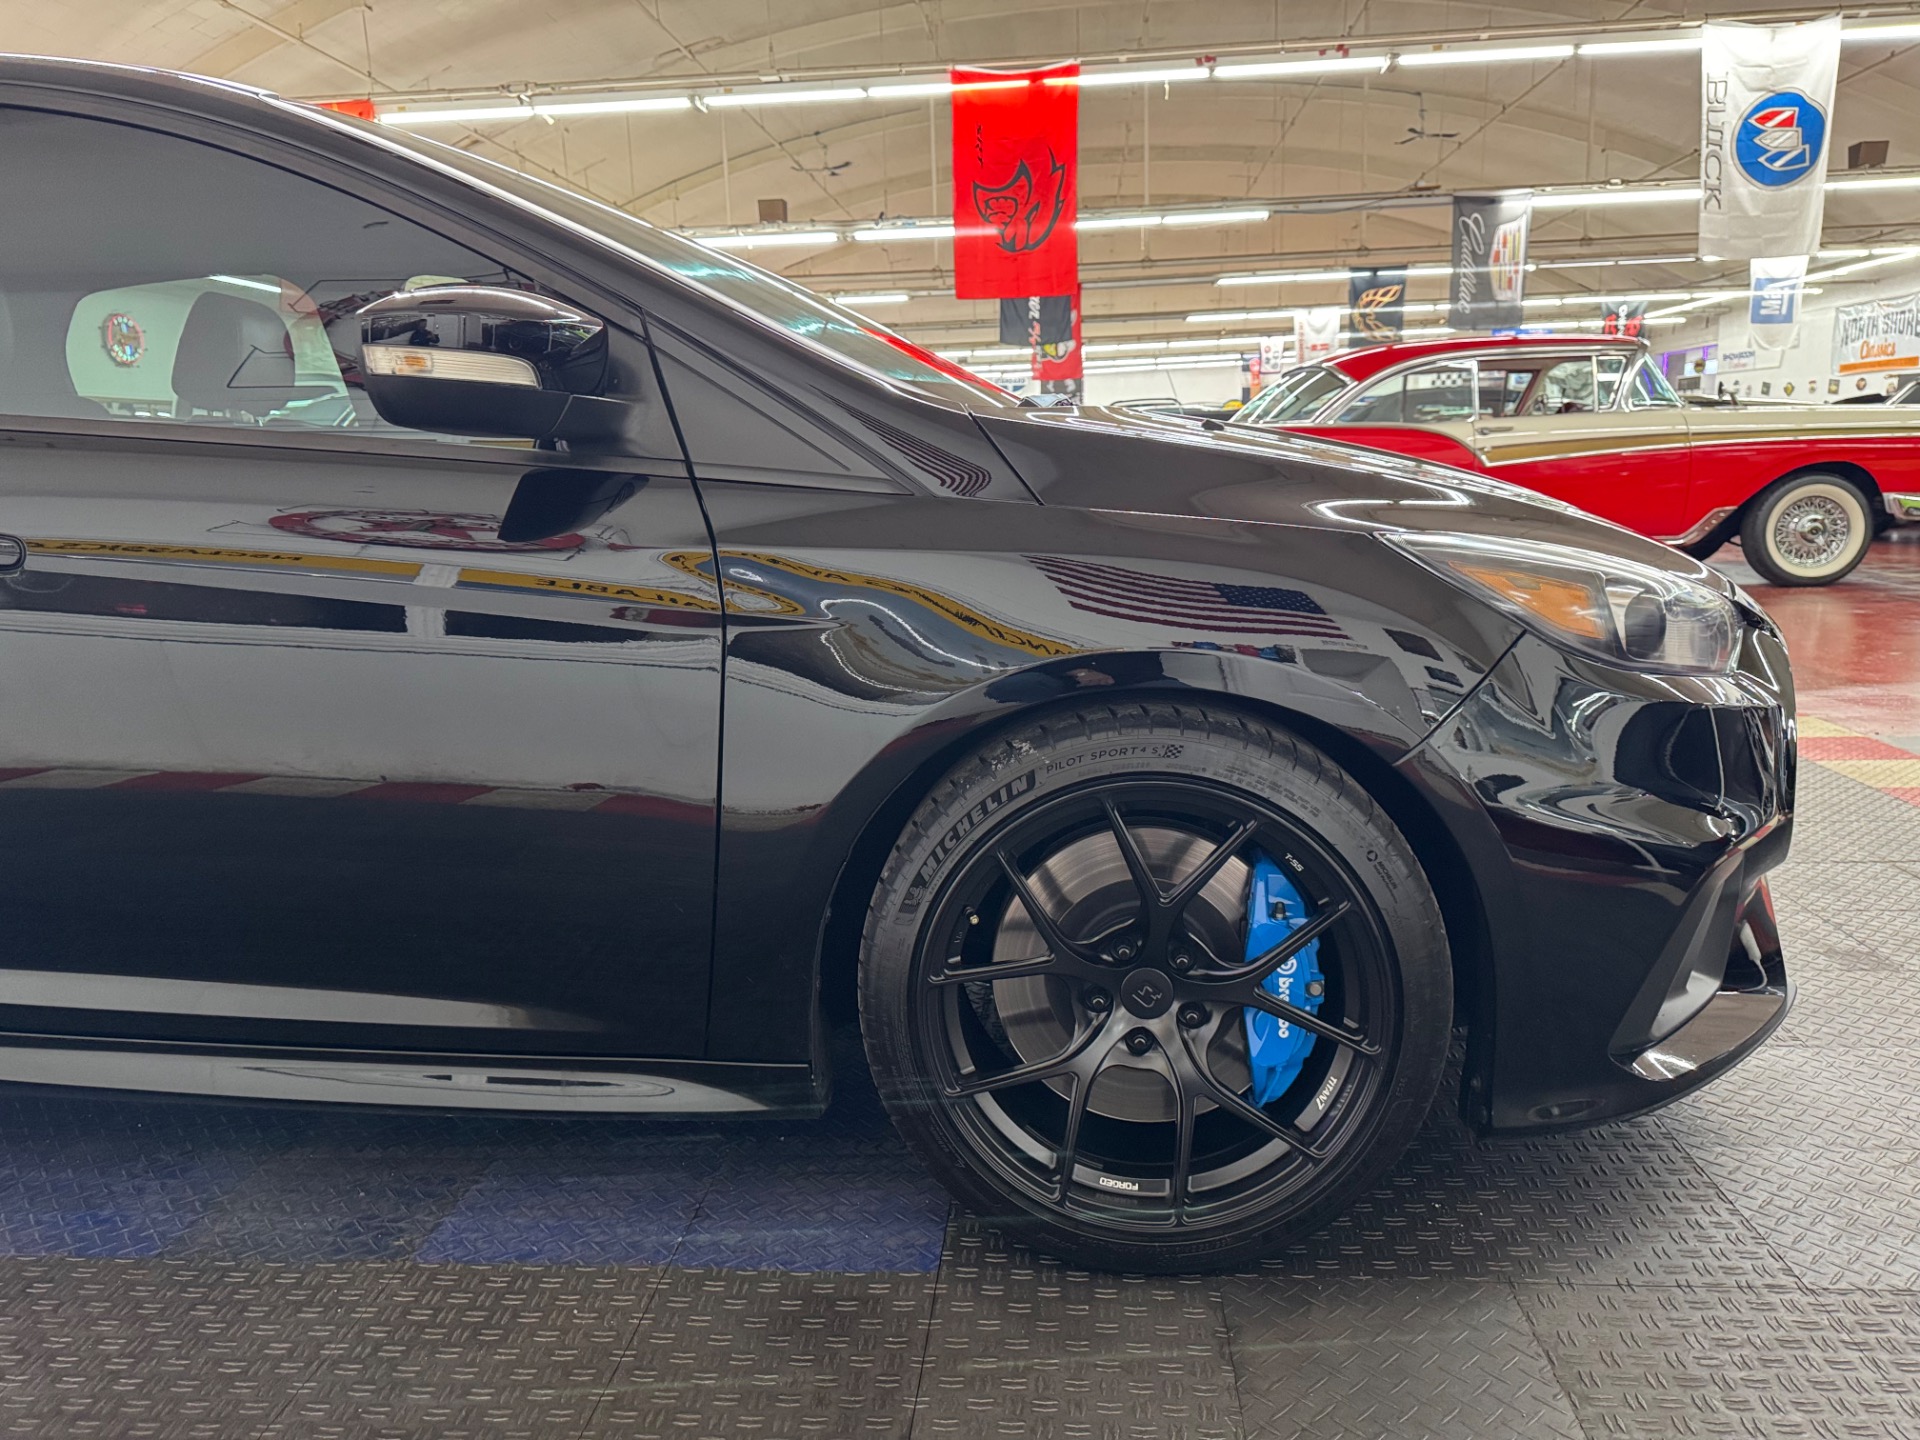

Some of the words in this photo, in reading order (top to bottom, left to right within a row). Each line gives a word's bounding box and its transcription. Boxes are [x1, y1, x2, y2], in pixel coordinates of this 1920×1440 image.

[1704, 72, 1728, 210] BUICK
[1459, 212, 1485, 314] Cadillac
[1840, 314, 1879, 348] NORTH
[1046, 754, 1084, 774] PILOT
[920, 774, 1028, 882] MICHELIN
[1315, 1076, 1338, 1111] TITAN7
[1099, 1176, 1139, 1191] FORGED
